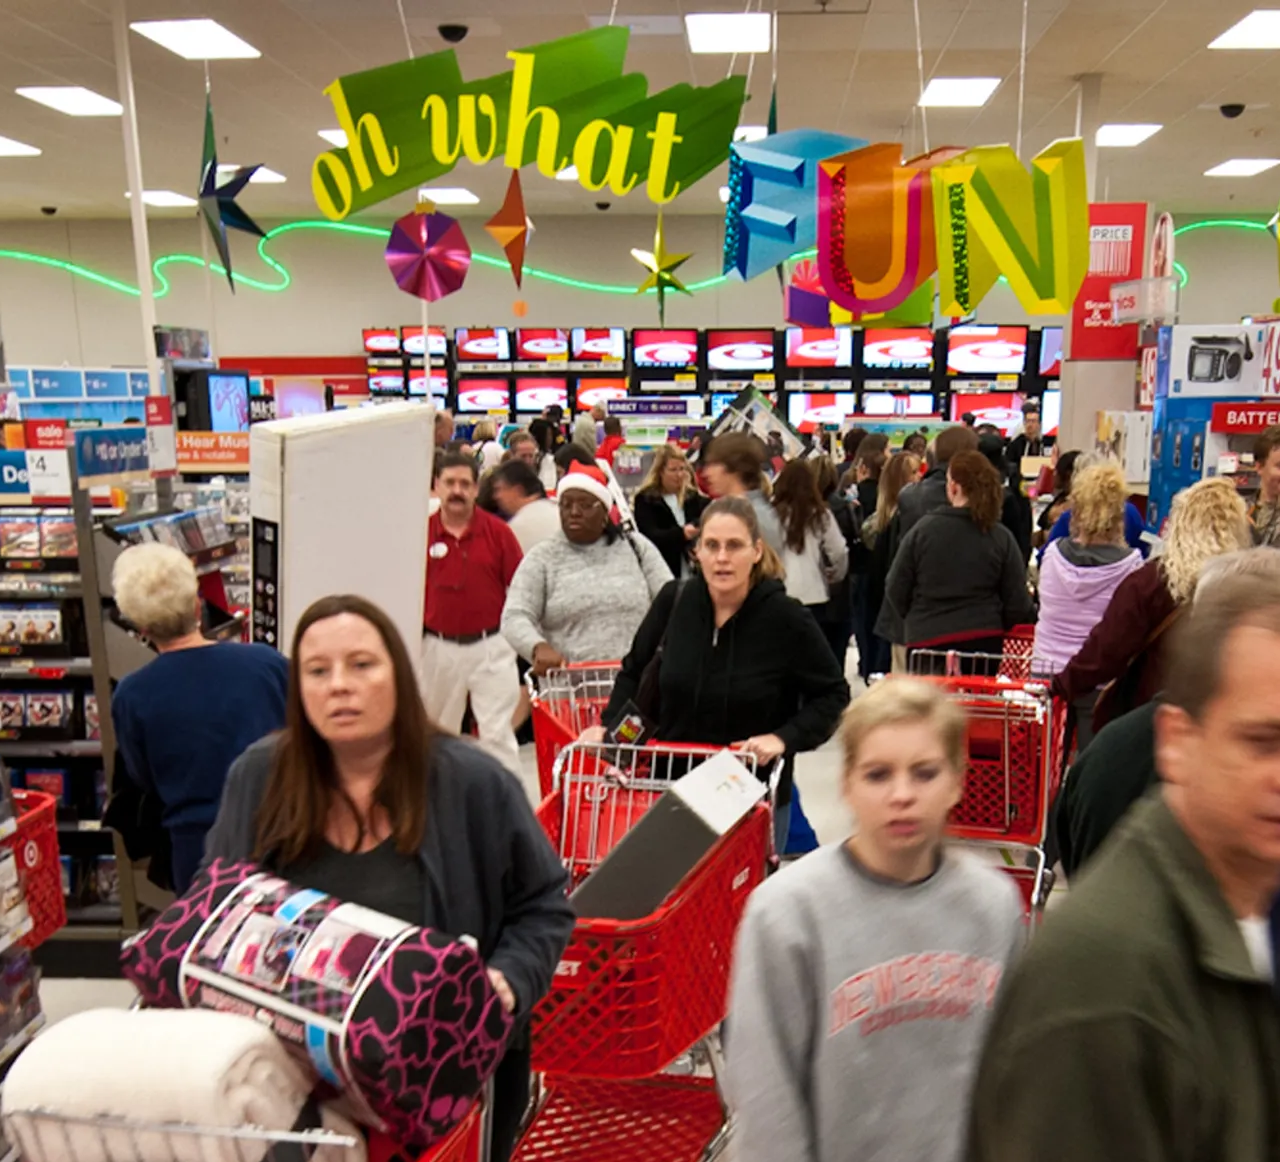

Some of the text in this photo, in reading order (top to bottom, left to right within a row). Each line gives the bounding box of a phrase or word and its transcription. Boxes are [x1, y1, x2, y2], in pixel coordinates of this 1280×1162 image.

[312, 51, 683, 222] oh what
[724, 135, 1089, 316] FUN
[1092, 228, 1129, 240] PRICE
[36, 425, 63, 438] sale
[183, 434, 215, 449] Hear
